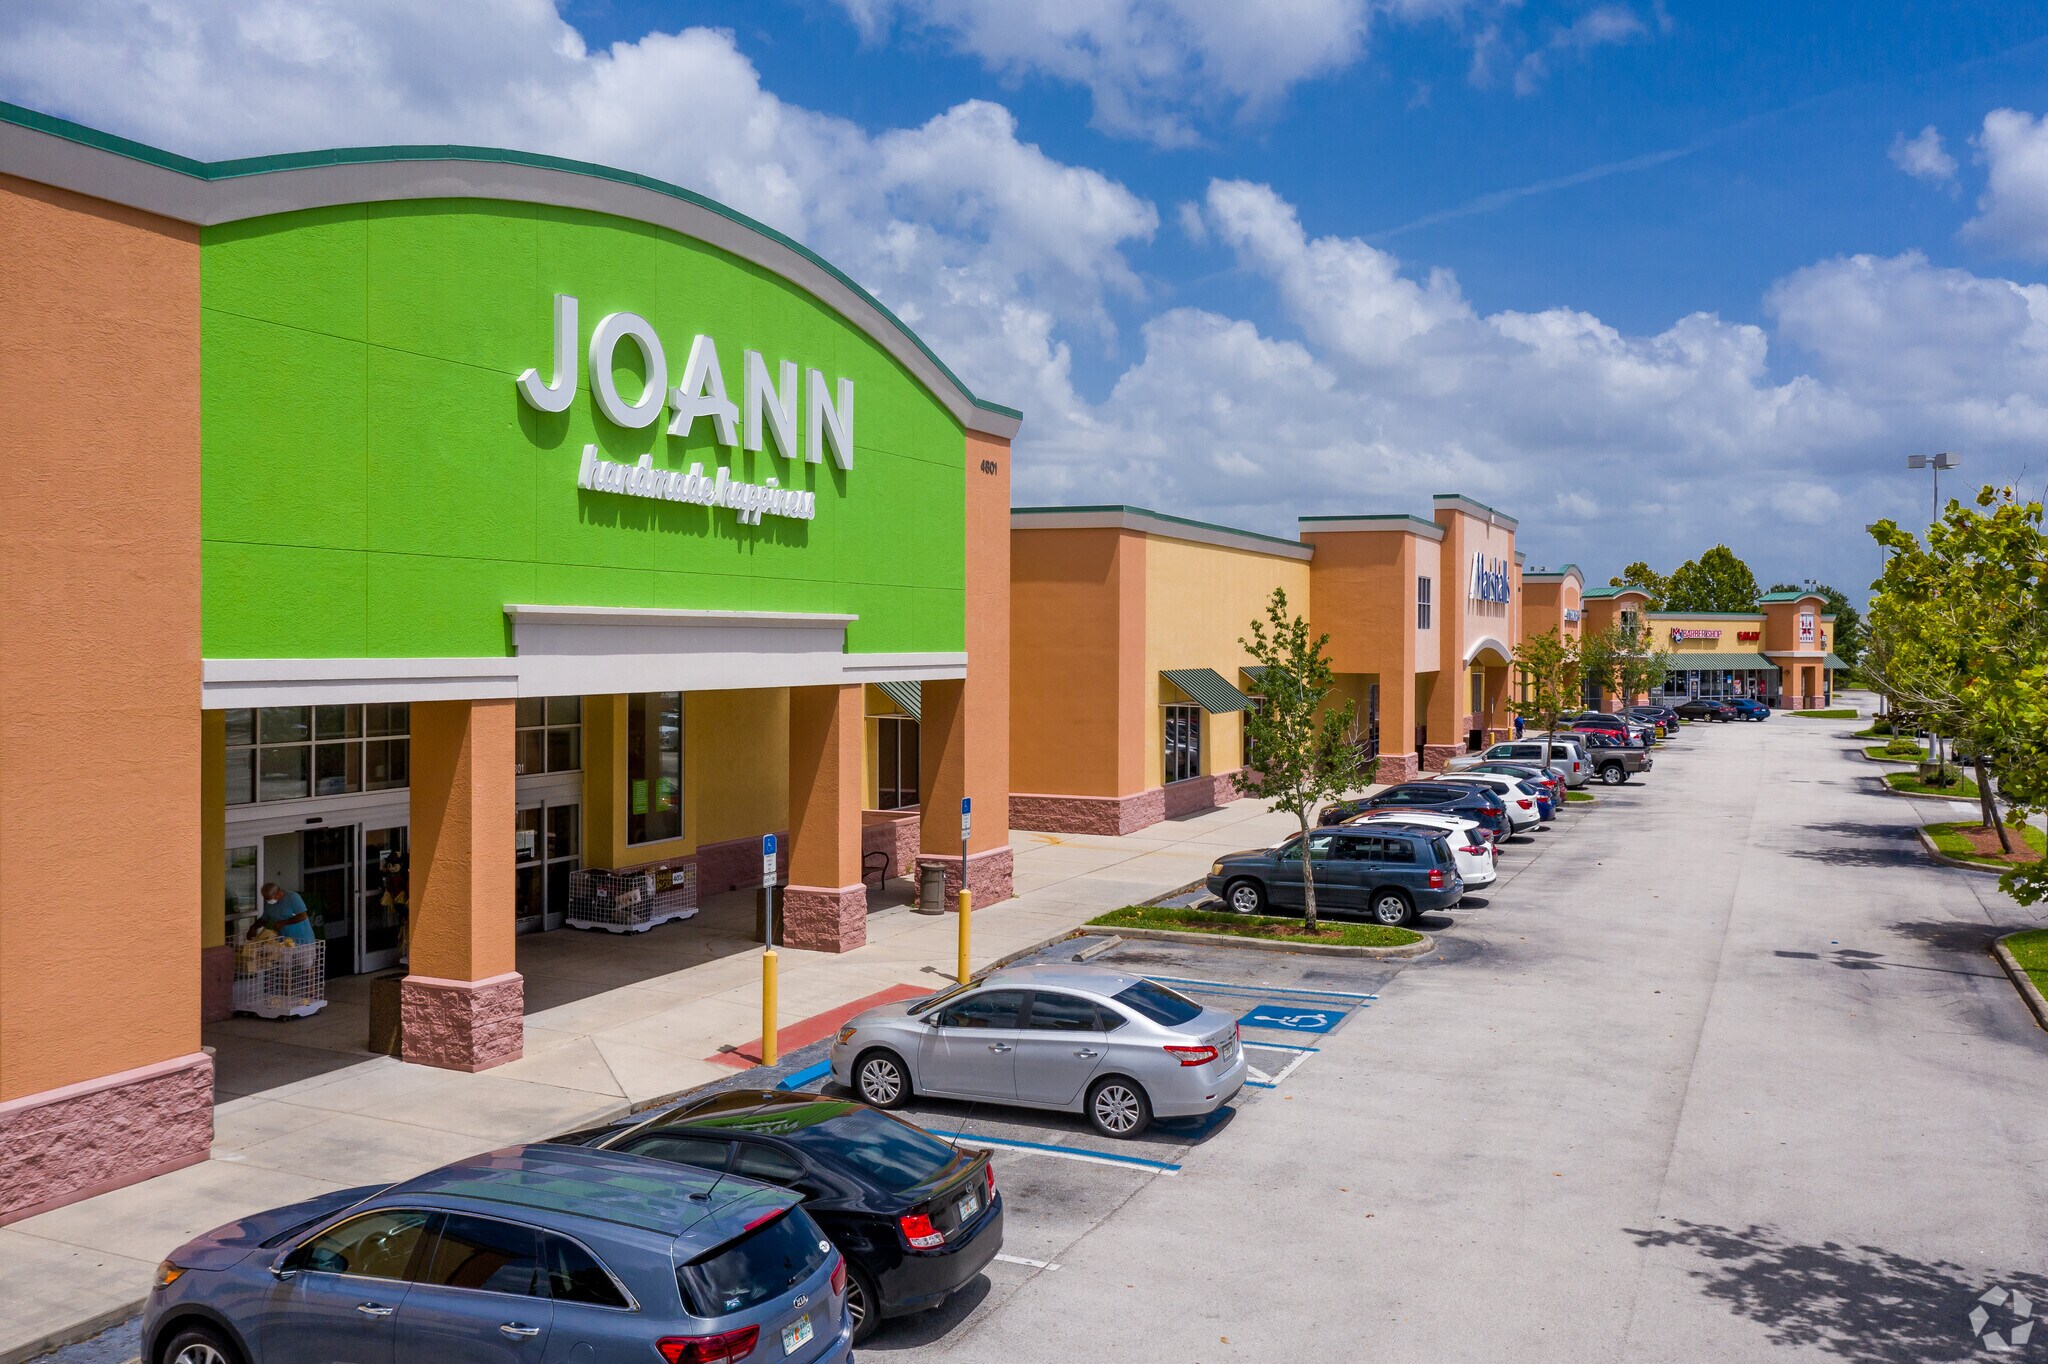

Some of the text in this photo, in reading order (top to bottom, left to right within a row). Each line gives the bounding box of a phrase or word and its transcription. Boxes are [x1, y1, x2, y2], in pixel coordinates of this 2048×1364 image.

[516, 293, 854, 471] JOANN
[577, 444, 815, 526] handmade happiness
